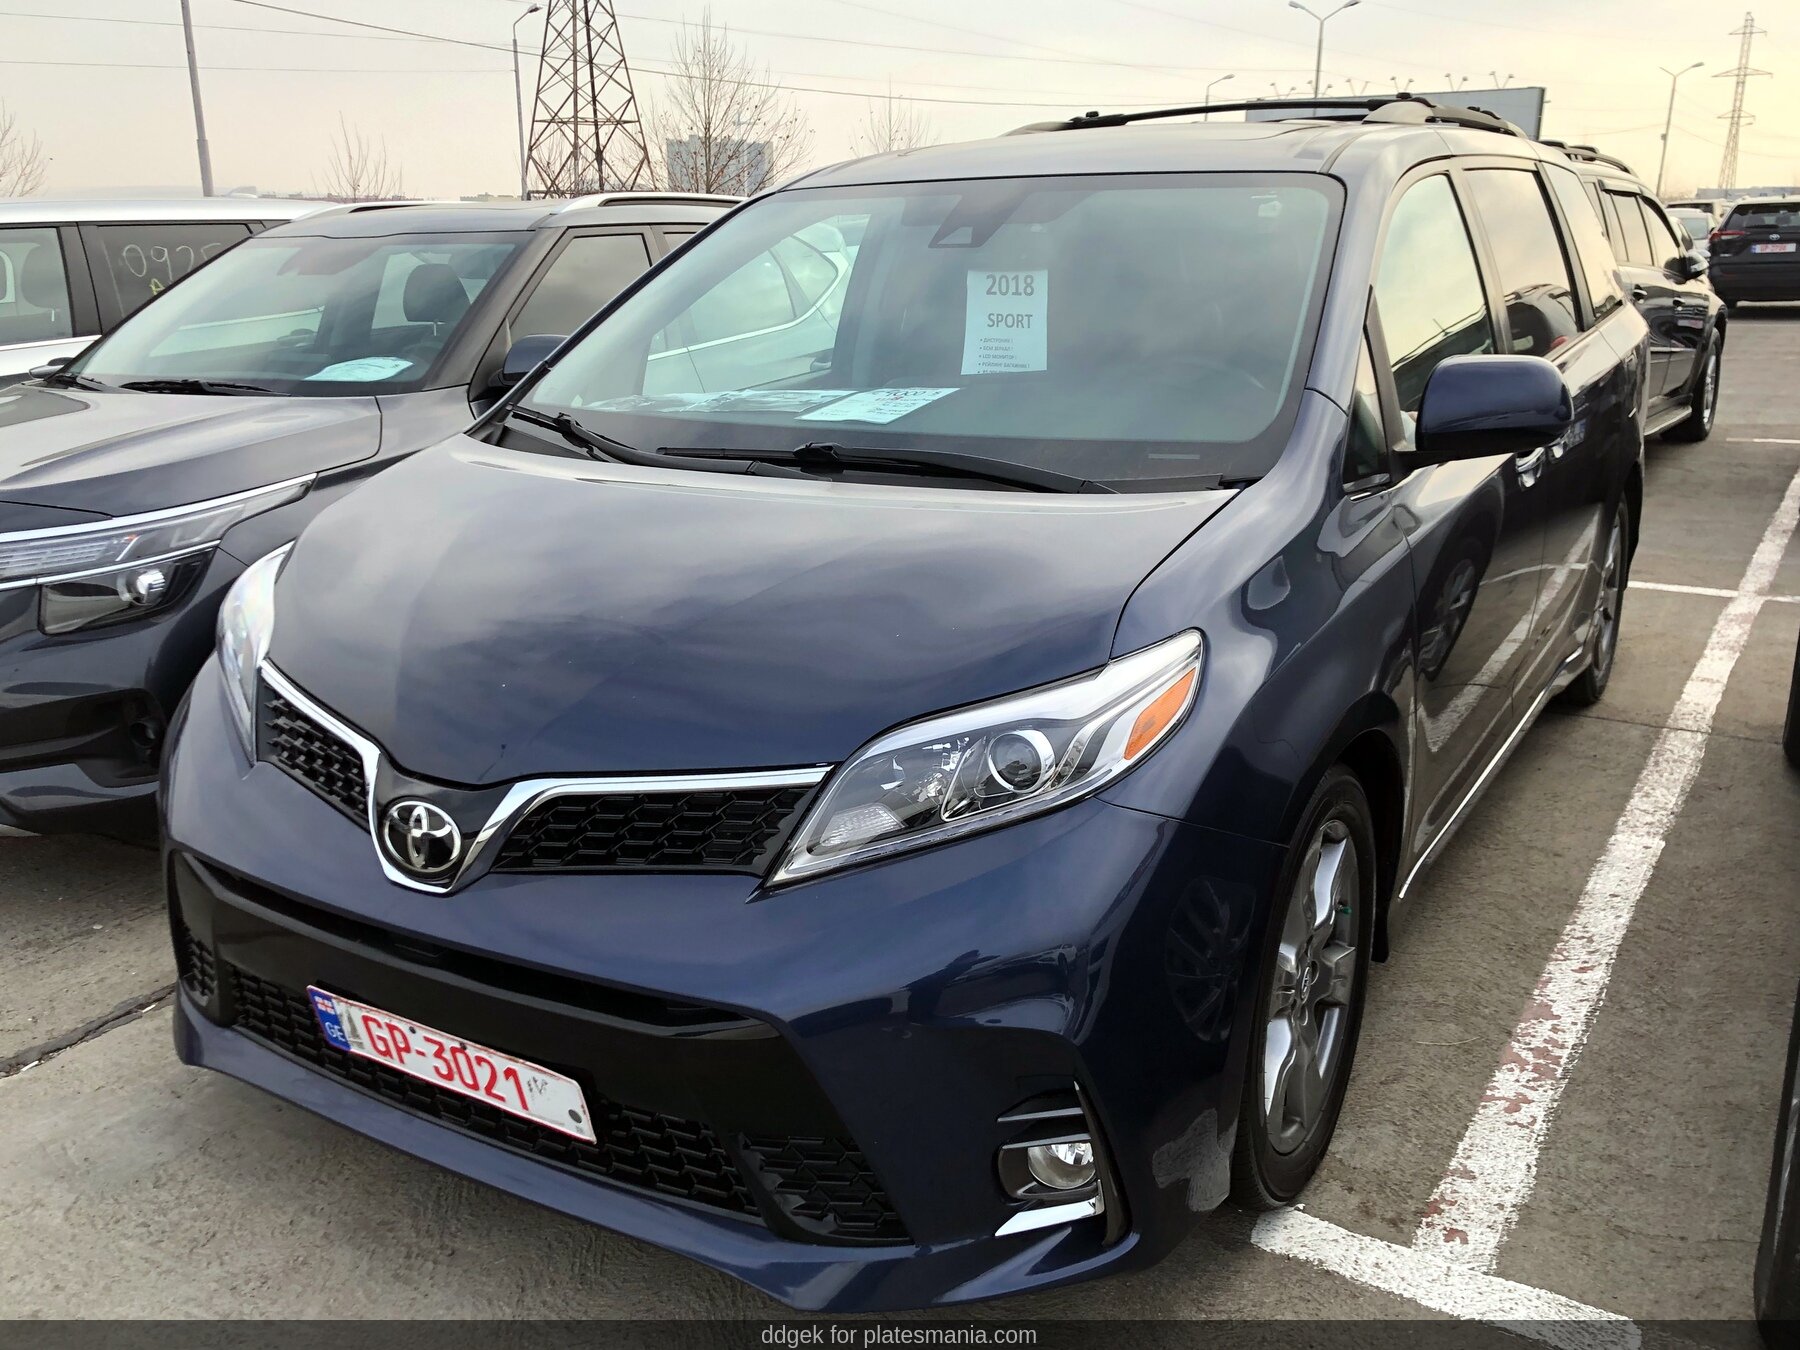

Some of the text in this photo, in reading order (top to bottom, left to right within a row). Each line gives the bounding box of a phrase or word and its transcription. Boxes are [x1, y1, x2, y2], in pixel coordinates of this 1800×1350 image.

[986, 274, 1034, 296] 2018
[987, 313, 1033, 328] SPORT
[325, 1020, 347, 1043] GE
[361, 1014, 529, 1112] GP-3021
